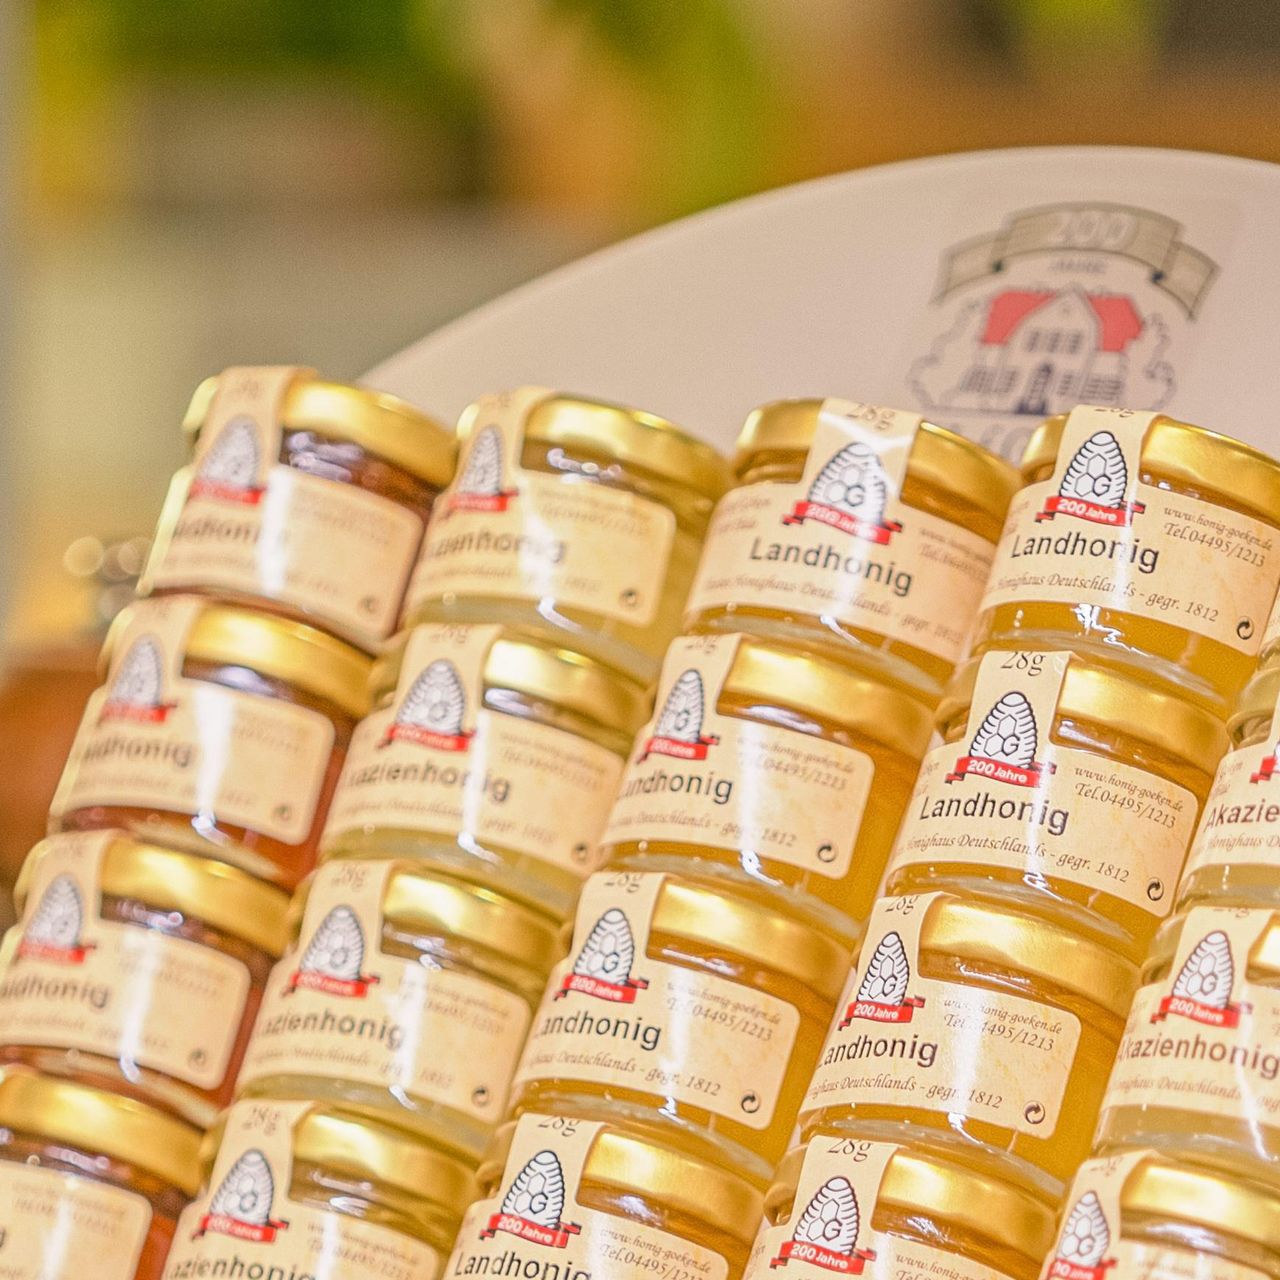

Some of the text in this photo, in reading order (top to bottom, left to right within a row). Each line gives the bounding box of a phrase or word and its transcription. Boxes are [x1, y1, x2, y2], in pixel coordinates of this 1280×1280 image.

[1056, 498, 1118, 523] 200 Jahre
[1164, 522, 1266, 568] Tel.04495/1213
[750, 537, 912, 597] Landhonig
[1148, 592, 1219, 622] gegr. 1812
[1001, 652, 1047, 677] 28g
[966, 759, 1028, 783] 200 Jahre
[1074, 765, 1184, 812] www.honig-goeken.de
[1075, 782, 1176, 828] Tel.04495/1213
[1056, 852, 1091, 871] gegr.
[1097, 861, 1129, 883] 1812
[853, 1004, 899, 1020] 200 Jahre
[686, 1075, 720, 1096] 1812
[497, 1216, 553, 1243] 200 Jahre
[790, 1244, 848, 1269] 200 Jahre
